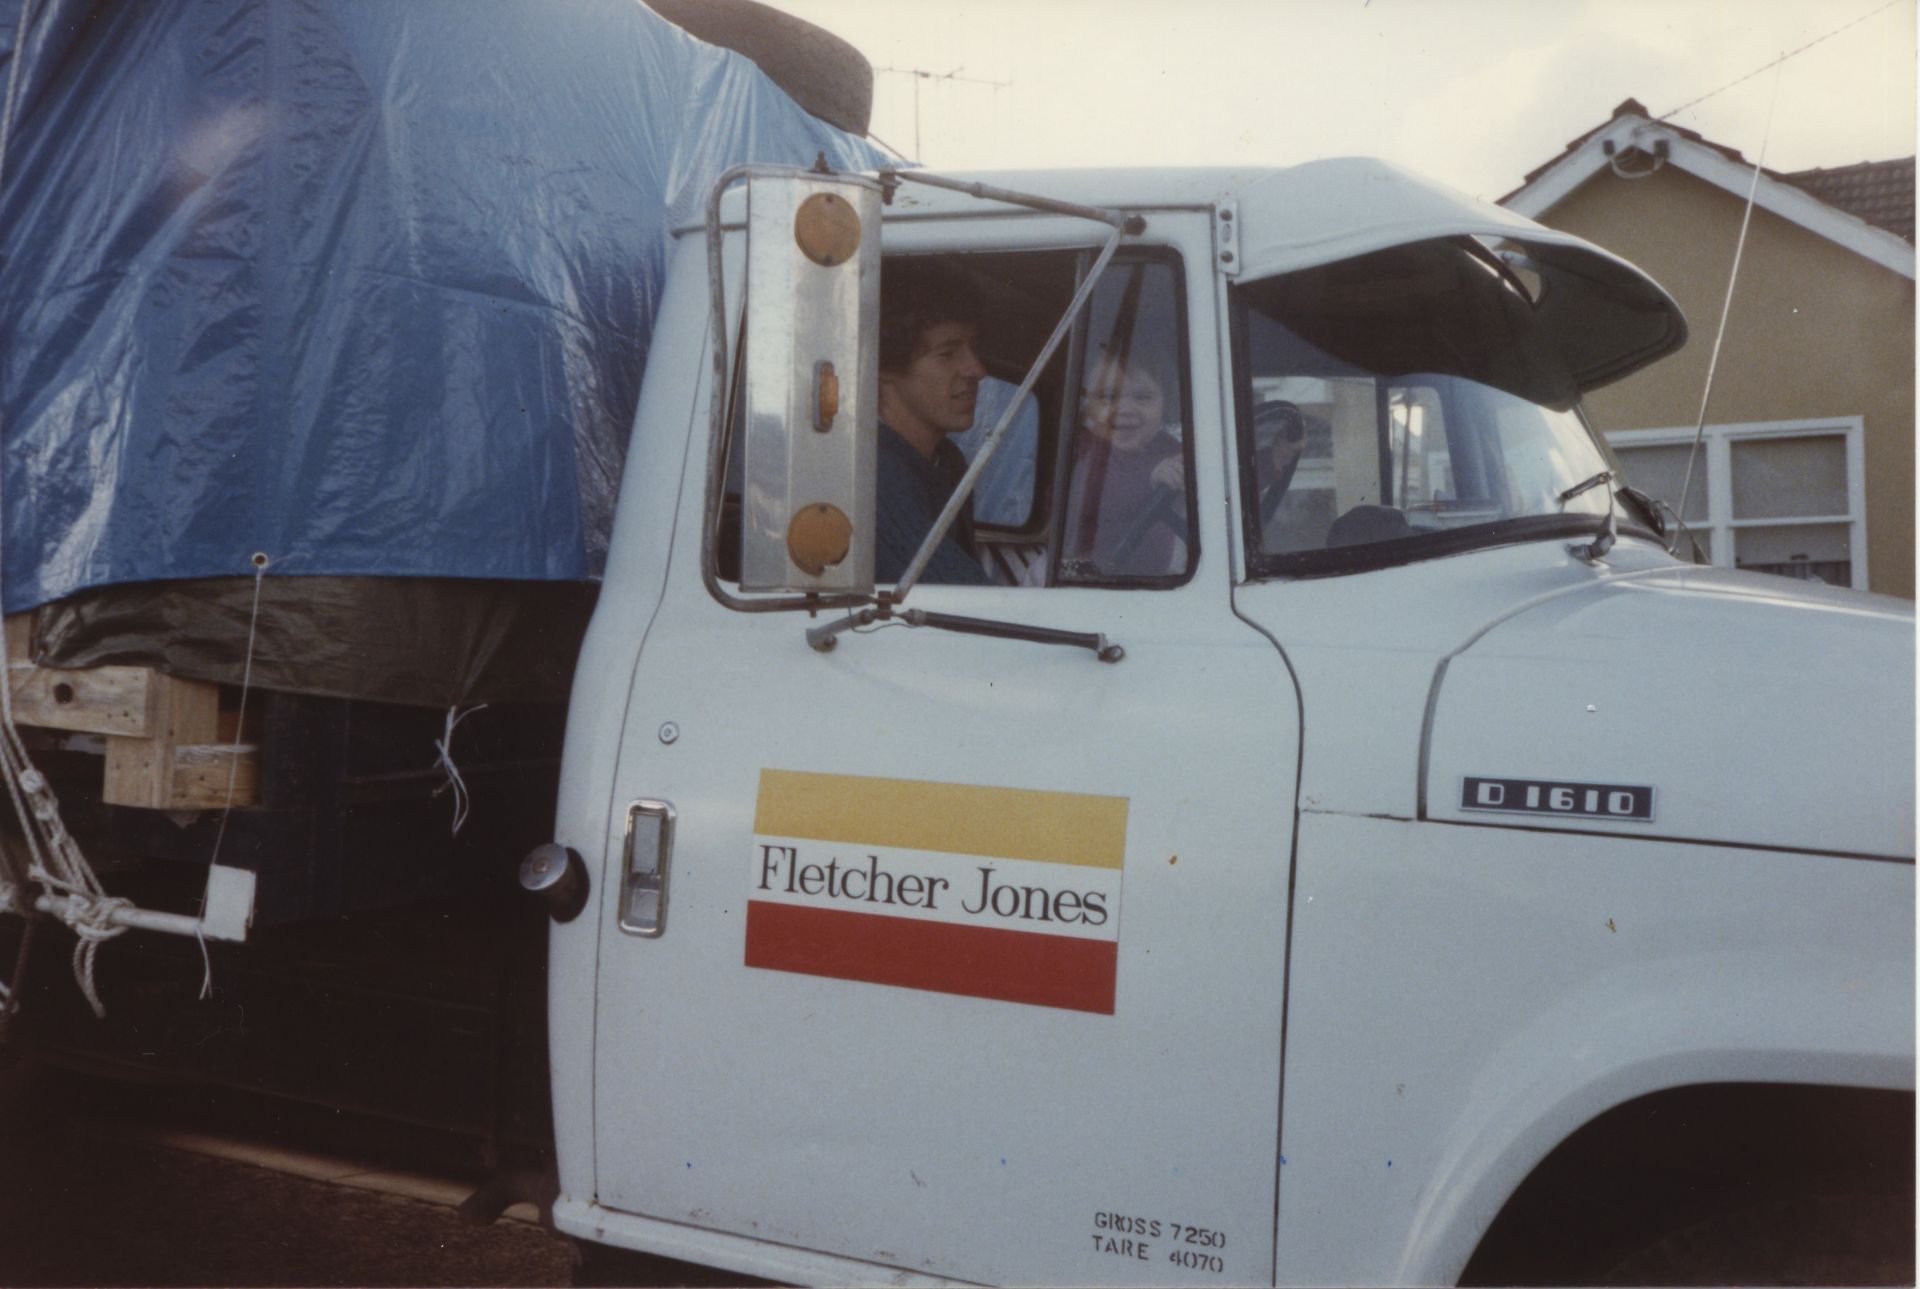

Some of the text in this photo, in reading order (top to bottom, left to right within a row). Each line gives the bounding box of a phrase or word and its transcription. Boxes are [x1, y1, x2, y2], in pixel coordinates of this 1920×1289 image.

[1476, 781, 1635, 815] D 1610
[756, 844, 1109, 926] Fletcher Jones
[1094, 1211, 1226, 1249] GROSS 7250
[1091, 1234, 1224, 1273] TARE 4070
